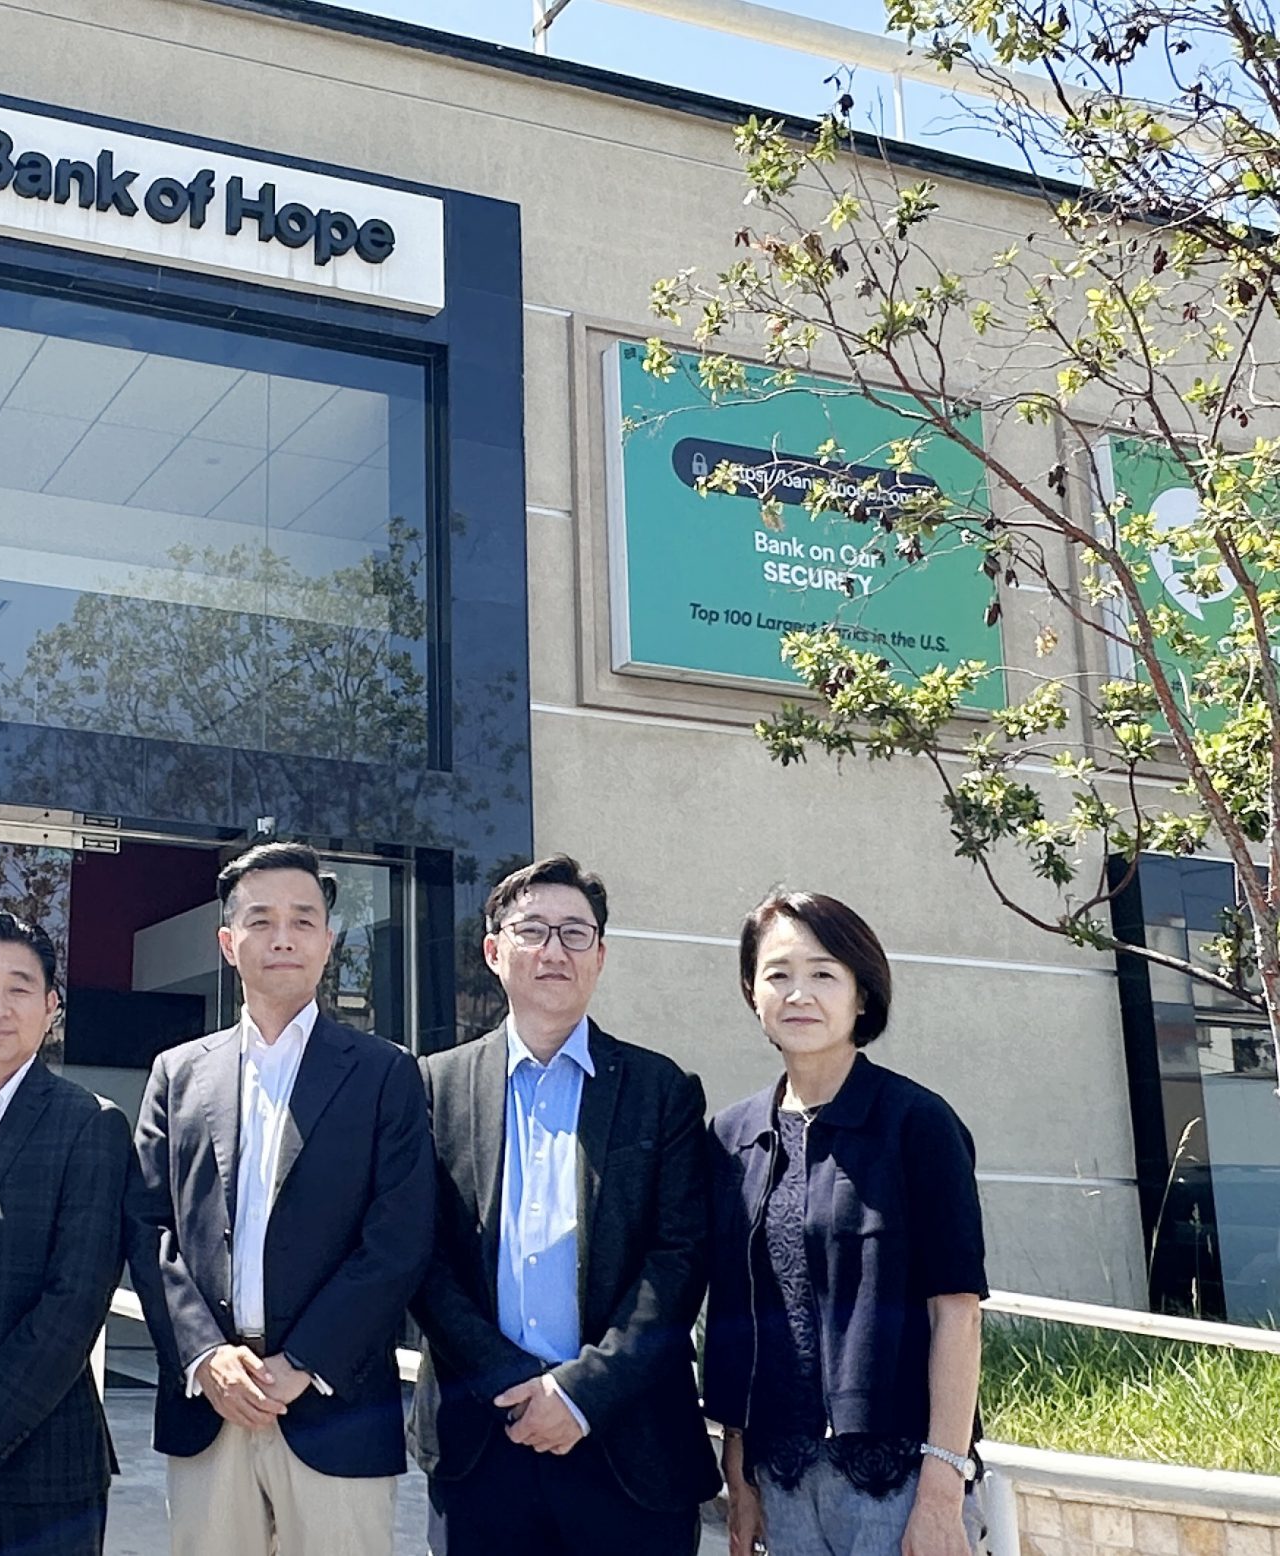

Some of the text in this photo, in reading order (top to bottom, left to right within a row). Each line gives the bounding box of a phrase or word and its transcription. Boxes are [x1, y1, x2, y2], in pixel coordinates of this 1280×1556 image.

[144, 168, 216, 230] of
[225, 175, 396, 266] Hope
[754, 530, 879, 569] Bank on Our
[689, 603, 720, 625] Top
[723, 609, 752, 627] 100
[890, 631, 916, 649] the
[920, 634, 950, 652] U.S.
